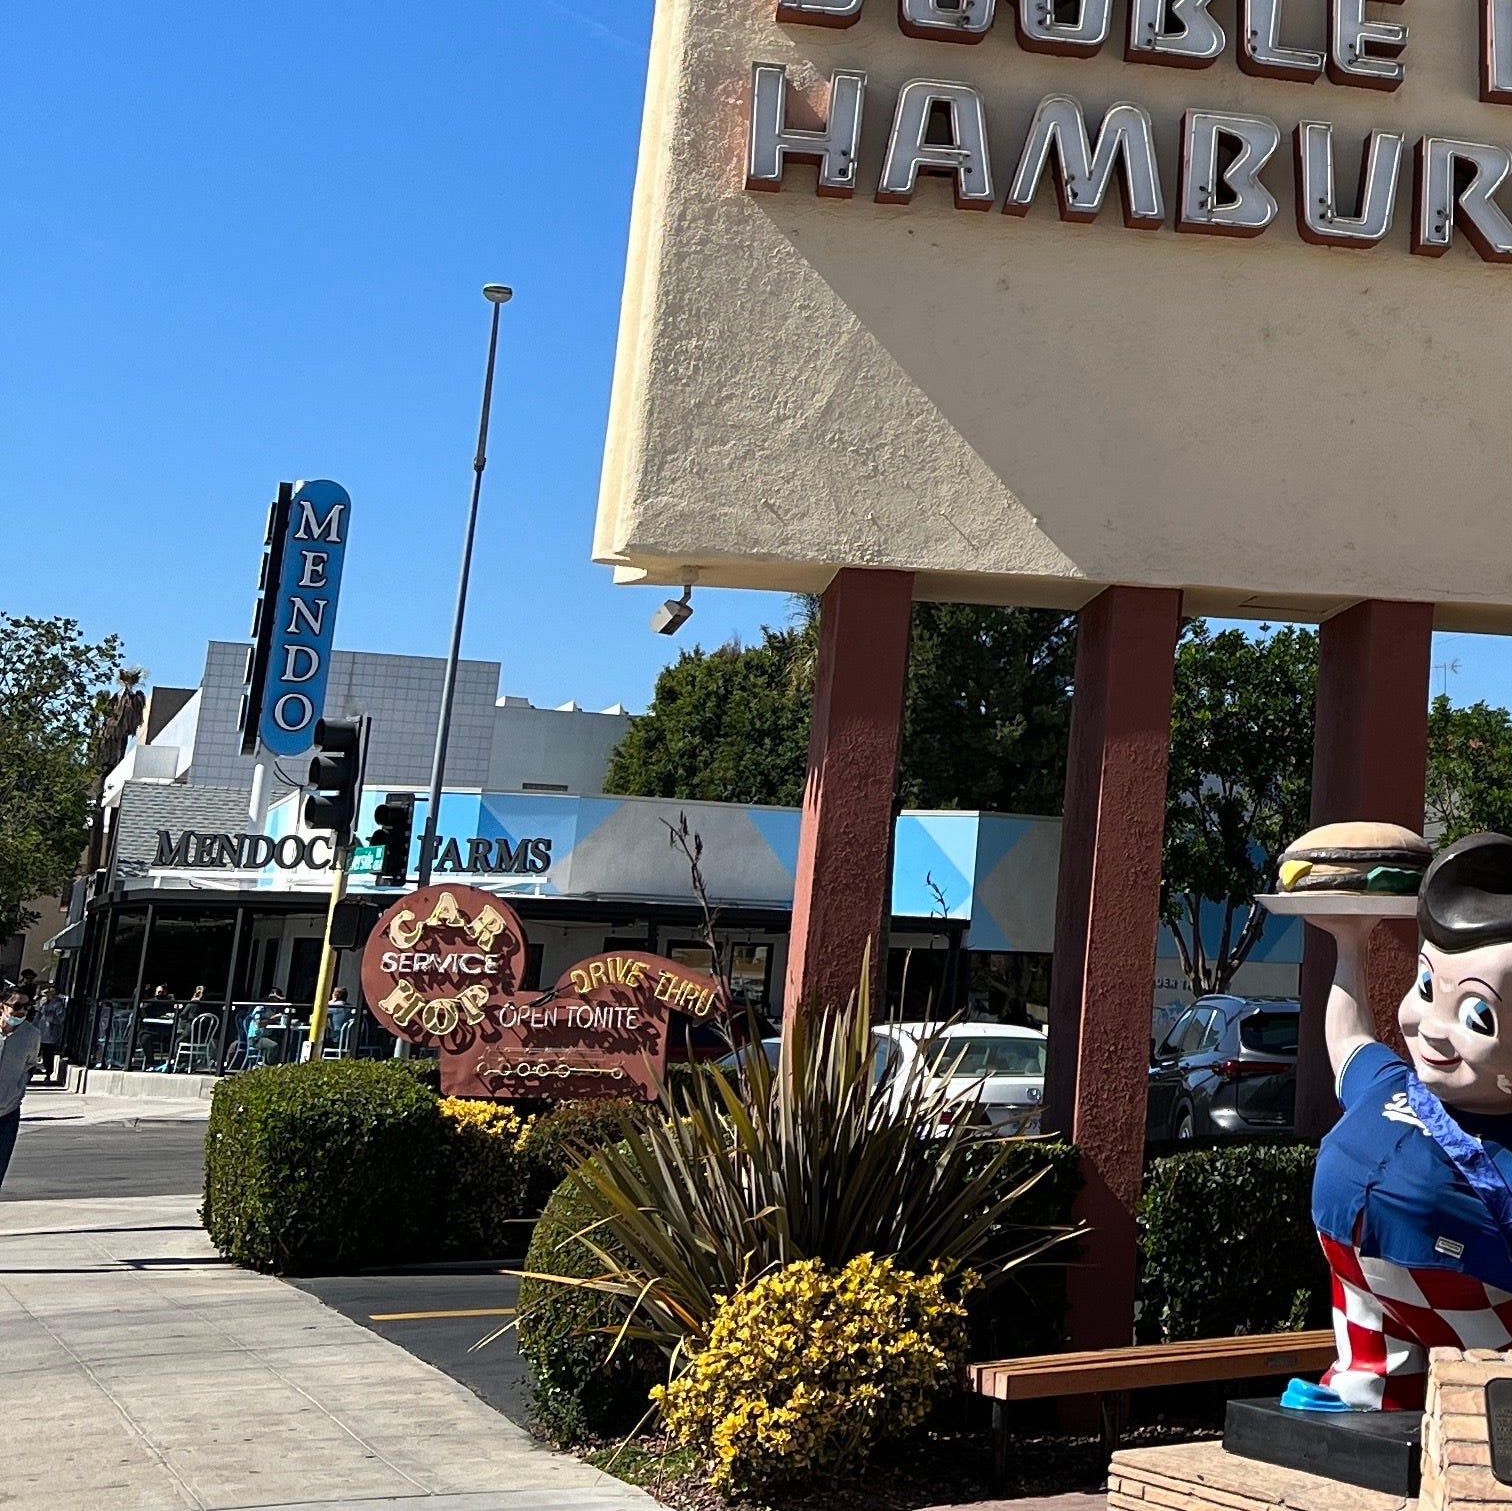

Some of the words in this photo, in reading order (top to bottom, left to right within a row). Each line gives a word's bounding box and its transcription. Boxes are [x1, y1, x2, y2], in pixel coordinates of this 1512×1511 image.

[274, 499, 345, 732] MENDO
[151, 830, 365, 871] MENDOC
[389, 892, 505, 952] CAR
[380, 952, 500, 974] SERVICE
[570, 957, 650, 994] DRIVE
[654, 969, 716, 1016] THRU
[378, 979, 490, 1035] HOP
[500, 1001, 557, 1029] OPEN
[566, 1005, 640, 1030] TONITE
